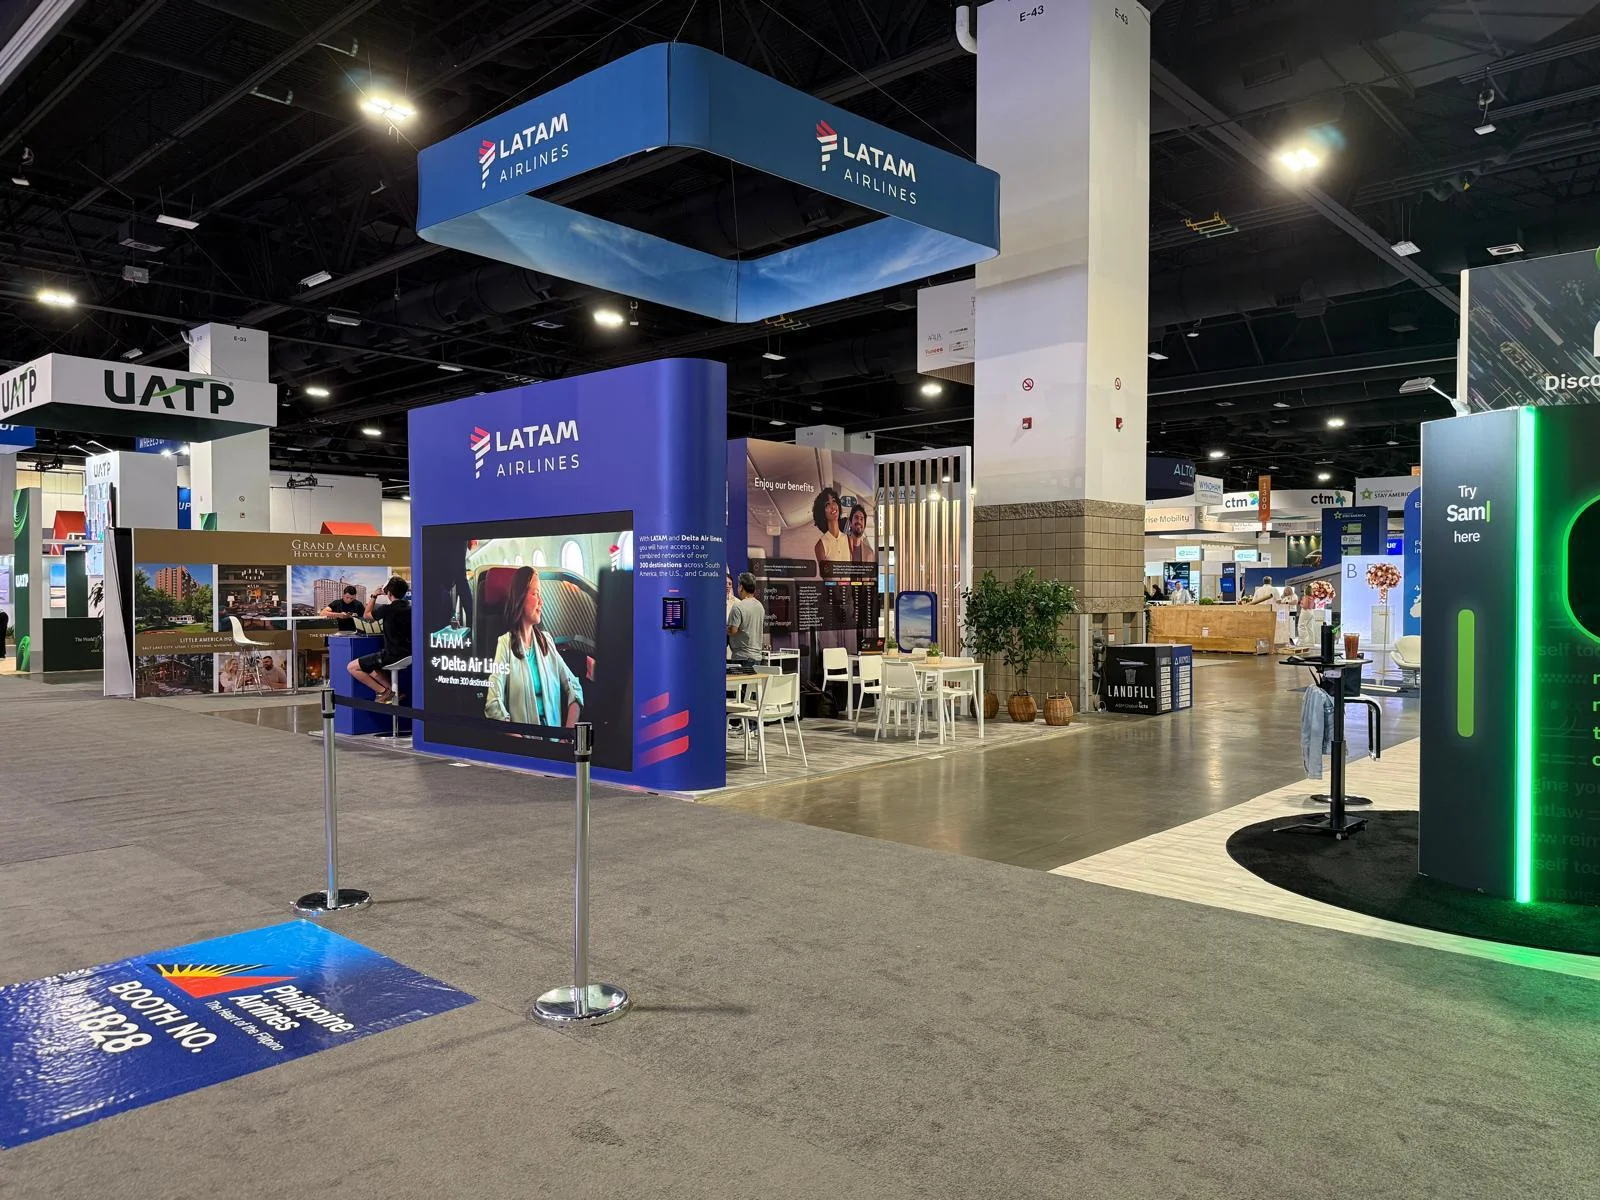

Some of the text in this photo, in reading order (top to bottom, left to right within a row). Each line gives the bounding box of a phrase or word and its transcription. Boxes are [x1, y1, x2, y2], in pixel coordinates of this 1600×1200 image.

[1019, 5, 1044, 22] E-43
[1115, 7, 1129, 25] E-43
[500, 112, 569, 159] LATAM
[500, 143, 569, 183] AIRLINES
[843, 136, 917, 183] LATAM
[844, 168, 917, 205] AIRLINES
[2, 368, 37, 413] UATP
[104, 369, 235, 415] UATP
[495, 419, 579, 452] LATAM
[93, 461, 111, 478] UATP
[496, 454, 580, 478] AIRLINES
[754, 477, 815, 493] Enjoy our benefits
[1458, 485, 1477, 500] Try
[1225, 497, 1248, 509] ctm
[1311, 492, 1334, 505] ctm
[1145, 514, 1190, 523] rise Mobility
[338, 540, 387, 552] AMERICA
[1454, 531, 1480, 544] here
[430, 632, 463, 649] LATAM
[441, 655, 510, 675] Delta Air Lines
[1108, 685, 1156, 699] LANDFILL
[108, 980, 217, 1053] BOOTH NO.
[228, 994, 300, 1032] Airlines
[263, 985, 354, 1033] Philippine
[76, 1005, 152, 1053] 1828
[204, 1000, 222, 1010] The
[216, 1008, 243, 1022] Heart
[241, 1025, 259, 1034] the
[253, 1032, 284, 1051] Filipino
